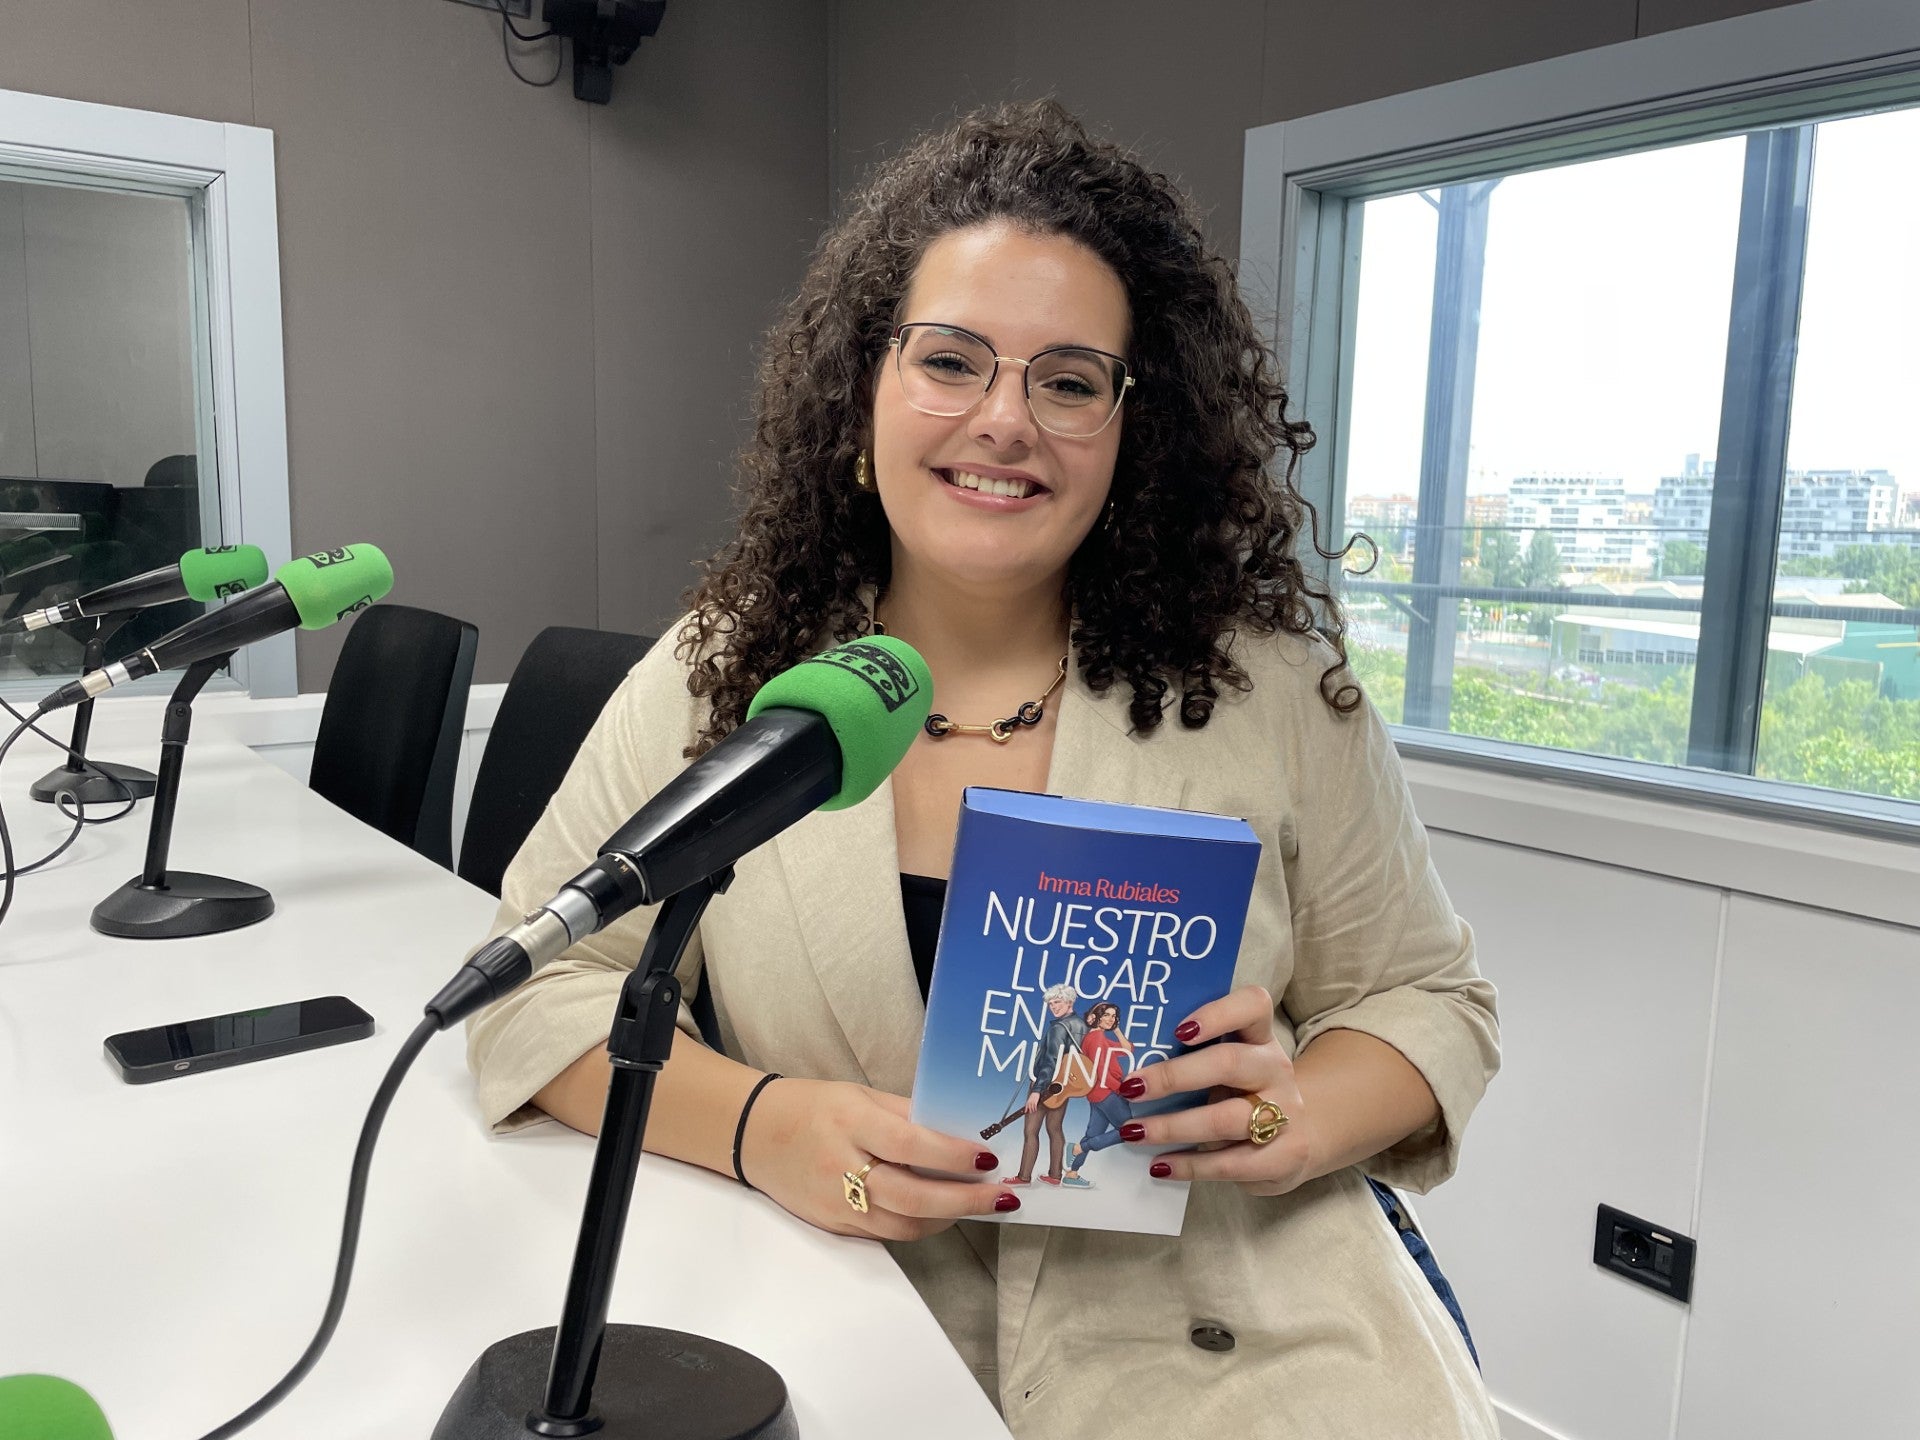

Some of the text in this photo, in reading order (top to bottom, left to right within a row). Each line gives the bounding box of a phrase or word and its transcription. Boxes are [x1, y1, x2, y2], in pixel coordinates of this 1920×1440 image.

[1038, 871, 1180, 904] Inma Rubiales
[983, 890, 1217, 960] NUESTRO
[1011, 946, 1171, 1005] LUGAR
[980, 989, 1173, 1050] EN EL
